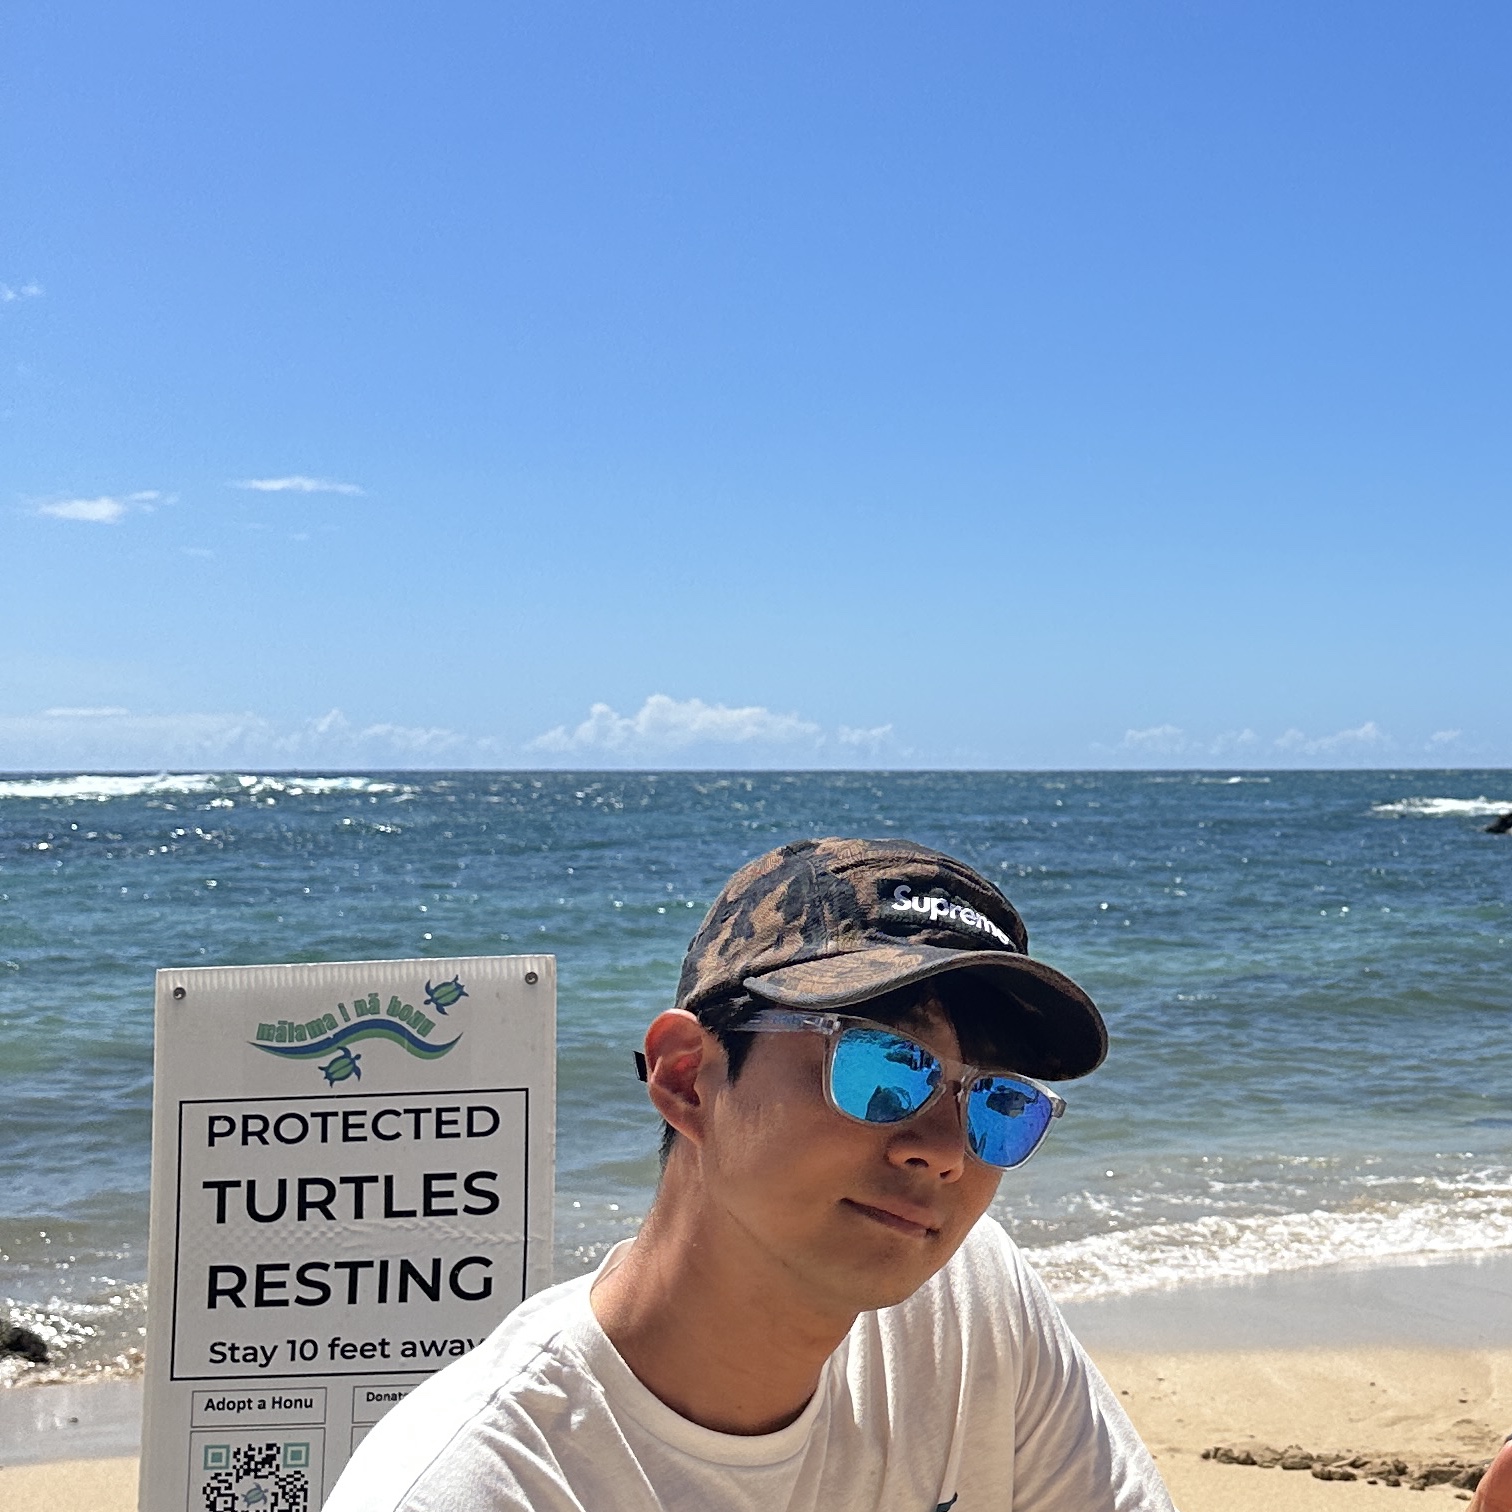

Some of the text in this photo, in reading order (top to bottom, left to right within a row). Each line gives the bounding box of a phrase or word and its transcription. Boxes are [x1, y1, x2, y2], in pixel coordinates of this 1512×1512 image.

[386, 995, 436, 1037] honu
[207, 1105, 500, 1147] PROTECTED
[202, 1171, 500, 1224] TURTLES
[207, 1256, 494, 1309] RESTING
[209, 1340, 278, 1368] Stay
[286, 1339, 318, 1362] 10
[328, 1337, 391, 1360] feet
[204, 1396, 313, 1413] Adopt a Honu
